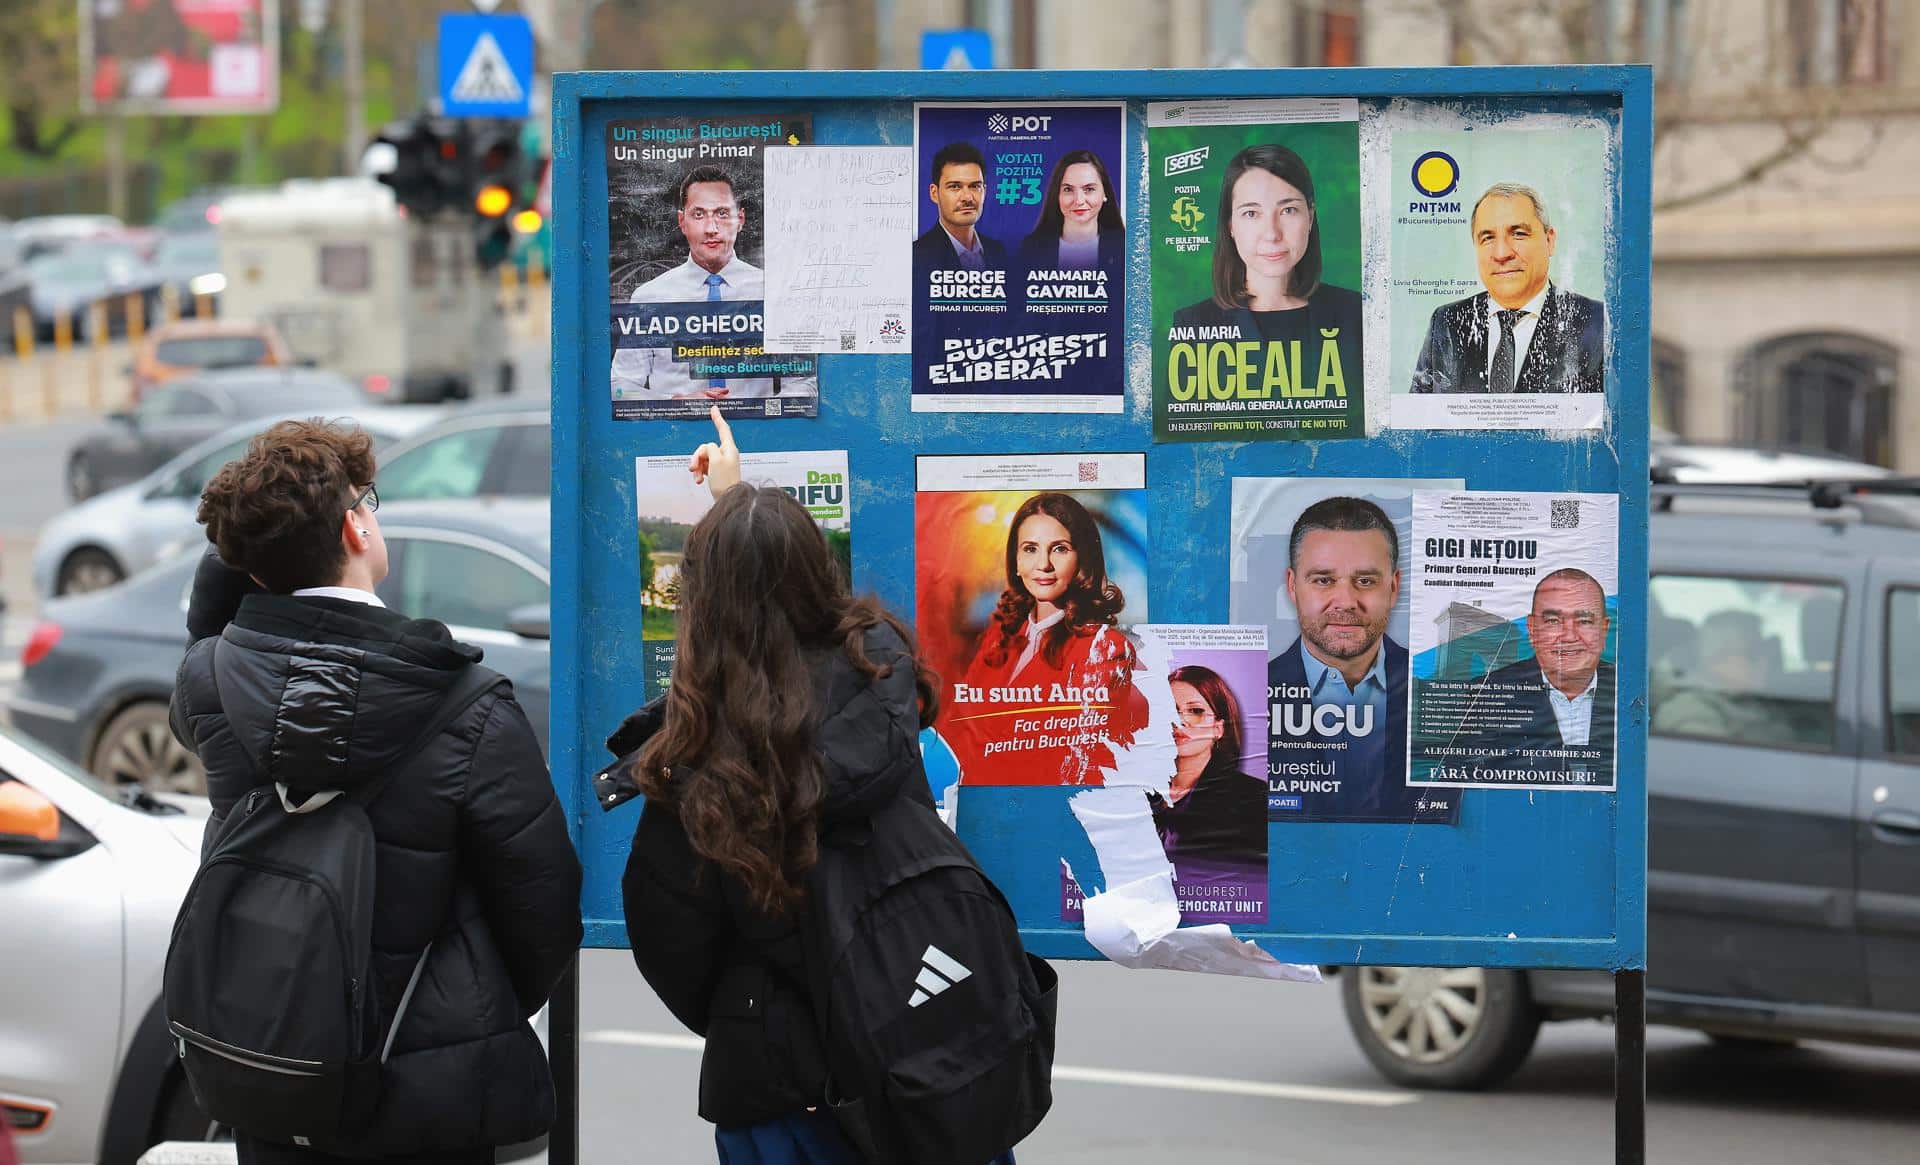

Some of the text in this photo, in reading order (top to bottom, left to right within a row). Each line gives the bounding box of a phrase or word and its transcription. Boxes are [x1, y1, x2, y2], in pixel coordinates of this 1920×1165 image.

[1012, 116, 1052, 132] POT
[613, 121, 783, 144] Un singur București
[614, 143, 756, 164] Un singur Primar
[996, 153, 1043, 166] VOTAȚI
[1169, 152, 1202, 171] sens
[996, 166, 1044, 178] POZIȚIA
[996, 178, 1043, 205] #3
[1174, 186, 1200, 196] POZIȚIA
[1166, 236, 1210, 244] PE BULETINUL
[1176, 244, 1200, 252] DE VOT
[930, 270, 1006, 284] GEORGE
[1027, 270, 1108, 281] ANAMARIA
[1412, 279, 1448, 287] Gheorghe
[930, 284, 1006, 298] BURCEA
[1026, 282, 1108, 299] GAVRILĂ
[962, 305, 1007, 314] BUCUREȘTI
[1026, 306, 1085, 314] PREȘEDINTE
[618, 314, 764, 336] VLAD GHEOR
[1168, 326, 1242, 340] ANA MARIA
[944, 333, 1108, 365] BUCUREȘTI
[696, 363, 736, 374] Unesc
[929, 357, 1068, 384] ELIBERAT
[1168, 327, 1347, 401] CICEALĂ
[1168, 399, 1348, 413] PENTRU PRIMĂRIA GENERALĂ A CAPITALEI
[1168, 422, 1178, 432] UN
[1214, 421, 1242, 430] PENTRU
[1266, 420, 1300, 430] CONSTRUIT
[1302, 420, 1312, 428] DE
[1313, 420, 1326, 428] NOI
[808, 470, 842, 484] Dan
[1425, 538, 1538, 564] GIGI NEȚOIU
[1424, 564, 1536, 578] Primar General București
[1454, 580, 1494, 588] Independent
[656, 646, 674, 654] Sunt
[656, 654, 676, 662] Fund
[953, 683, 1110, 704] Eu sunt Anca
[1014, 712, 1108, 733] Fac dreptate
[1267, 704, 1374, 738] IUCU
[984, 735, 1034, 757] pentru
[1272, 741, 1348, 751] #PentruBucurești
[1424, 747, 1466, 756] ALEGERI
[1468, 748, 1508, 757] LOCALE
[1522, 750, 1579, 758] DECEMBRIE
[1582, 750, 1601, 759] 2025
[1430, 766, 1597, 782] FĂRĂ COMPROMISURI!
[1269, 780, 1342, 793] LA PUNCT
[1430, 802, 1449, 810] PNL
[1066, 898, 1264, 912] PA EMOCRAT UNIT
